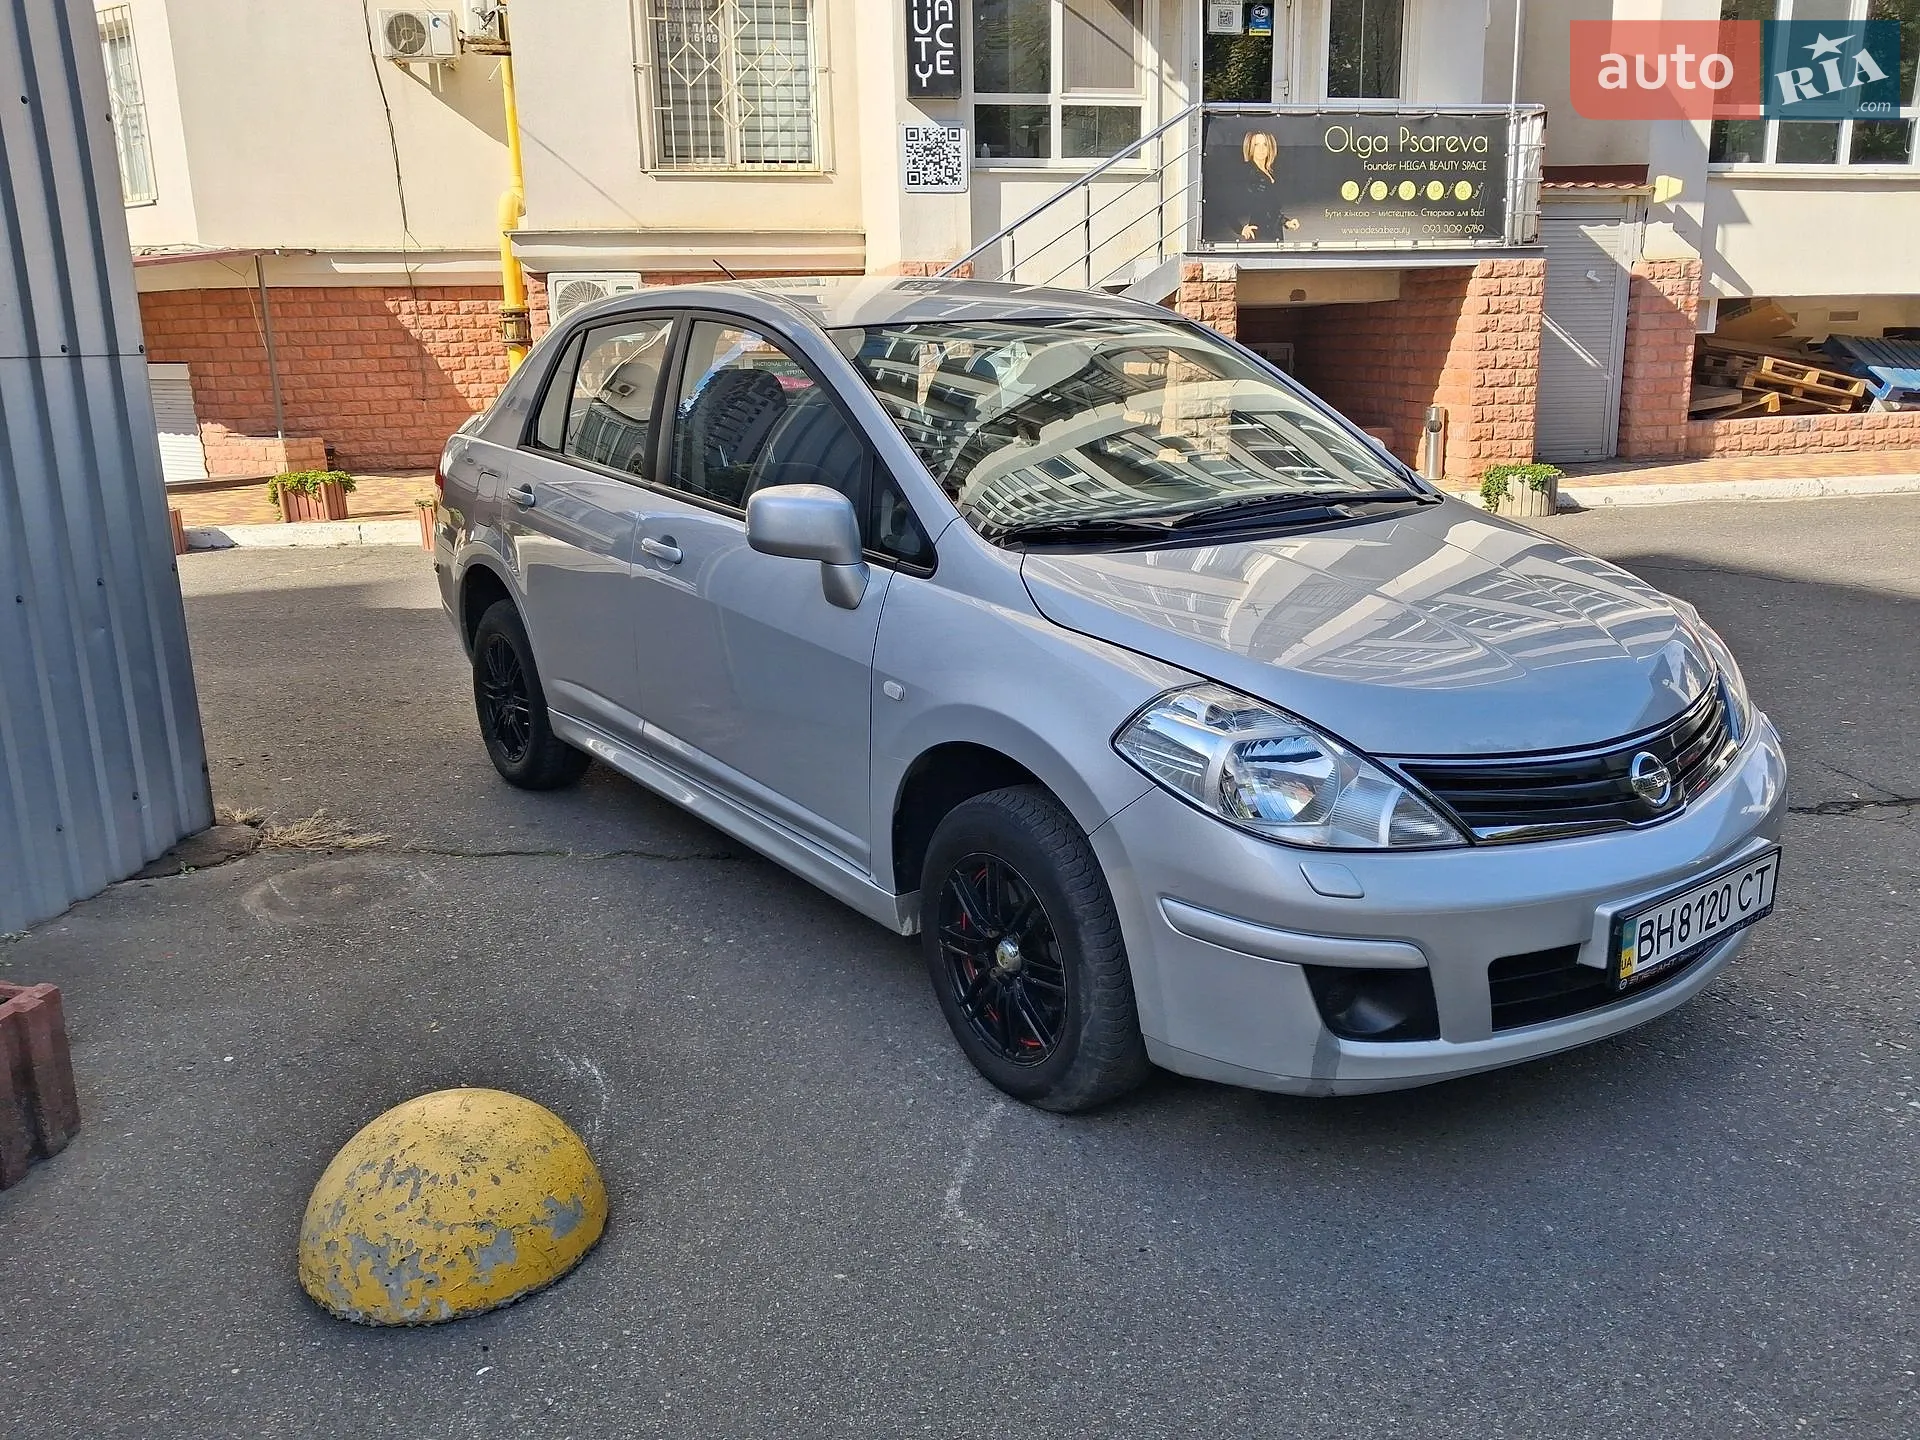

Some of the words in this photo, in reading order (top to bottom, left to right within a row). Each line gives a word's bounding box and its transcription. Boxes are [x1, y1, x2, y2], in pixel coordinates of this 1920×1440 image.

[1324, 125, 1389, 159] Olga
[1399, 126, 1488, 153] Psareva
[1363, 160, 1397, 171] Founder
[1399, 160, 1427, 171] HELGA
[1429, 160, 1460, 171] BEAUTY
[1462, 160, 1488, 171] SPACE
[1324, 208, 1342, 219] Бути
[1422, 224, 1441, 234] 093
[1443, 224, 1463, 234] 309
[1465, 224, 1485, 234] 6789
[1737, 863, 1772, 912] CT
[1621, 957, 1633, 971] UA
